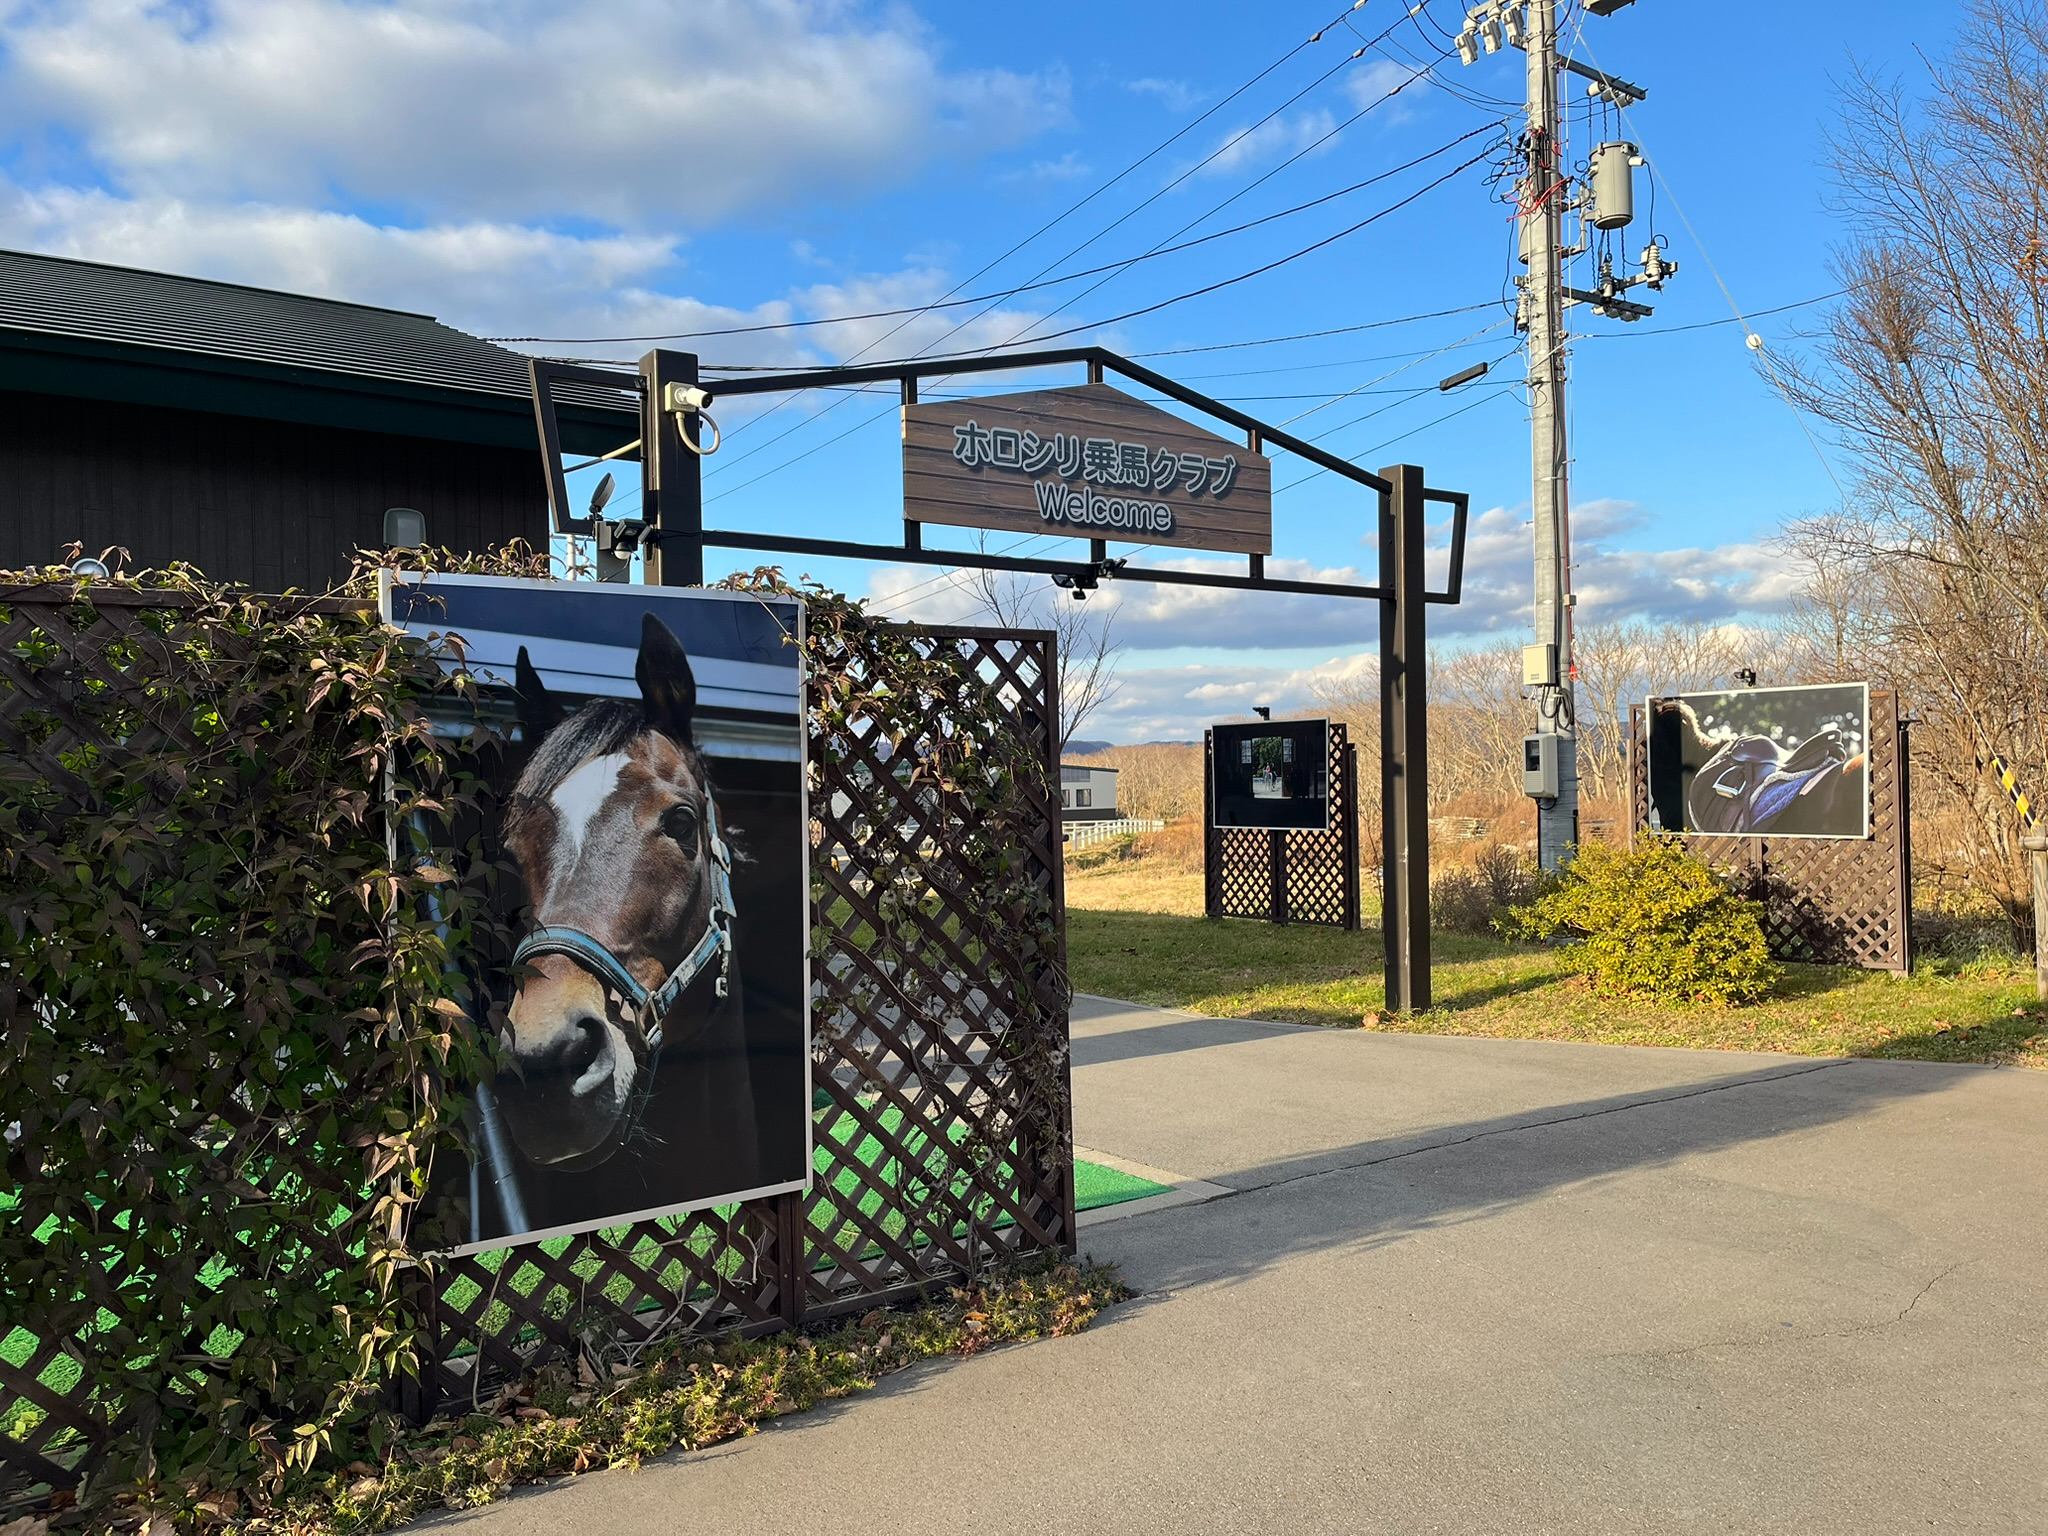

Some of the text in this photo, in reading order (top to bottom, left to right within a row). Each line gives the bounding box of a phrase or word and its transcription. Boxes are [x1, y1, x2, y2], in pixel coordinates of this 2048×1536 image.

[953, 420, 1236, 494] ホロシリ乗馬クラブ
[1035, 481, 1172, 531] Welcome
